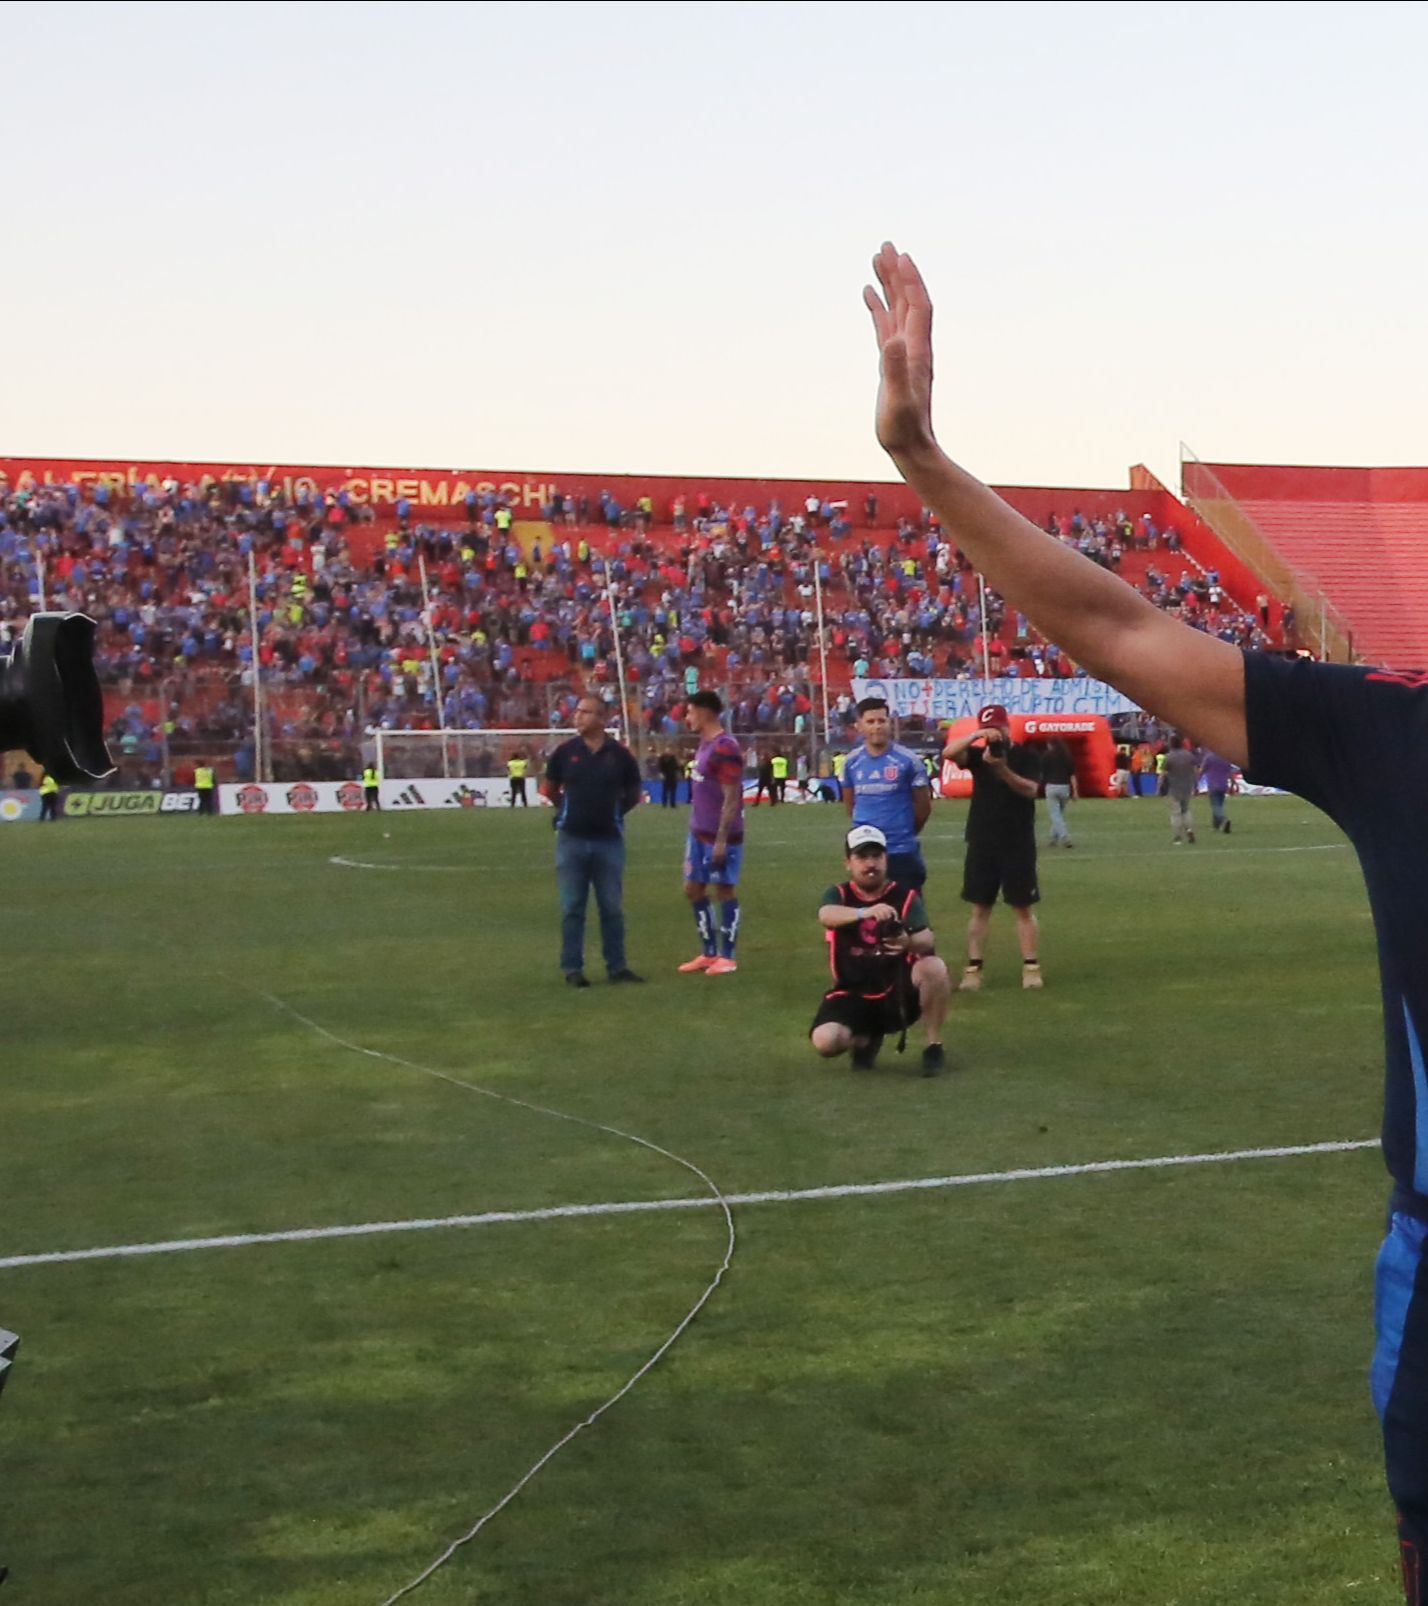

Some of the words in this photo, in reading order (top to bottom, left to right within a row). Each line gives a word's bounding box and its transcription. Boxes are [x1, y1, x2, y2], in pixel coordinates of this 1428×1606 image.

[1021, 680, 1043, 696] DE
[1039, 721, 1096, 732] GATORADE
[95, 793, 156, 811] JUGA
